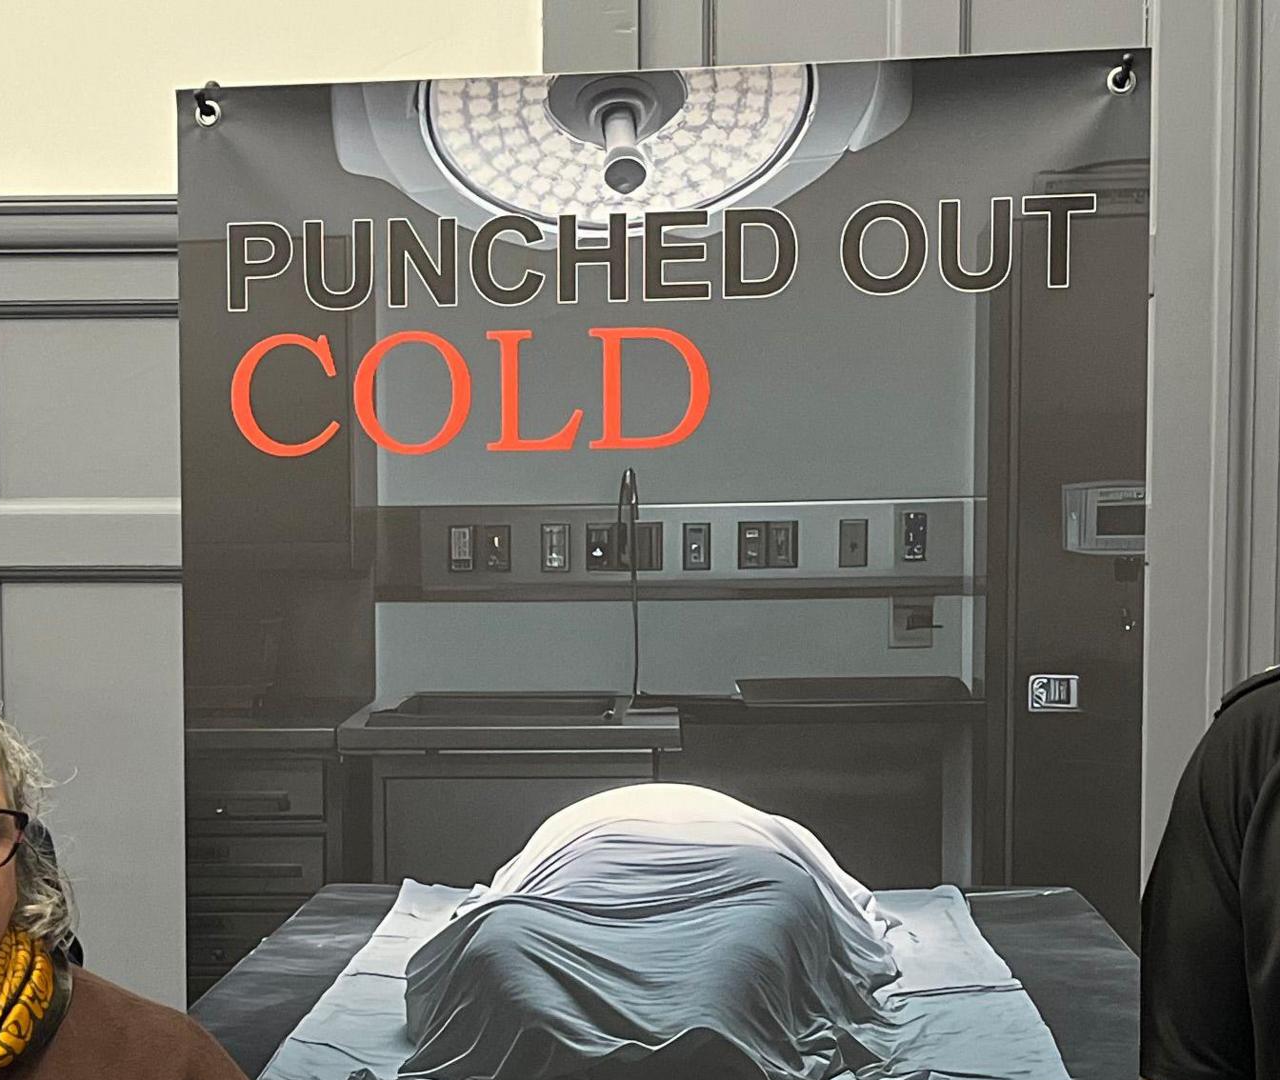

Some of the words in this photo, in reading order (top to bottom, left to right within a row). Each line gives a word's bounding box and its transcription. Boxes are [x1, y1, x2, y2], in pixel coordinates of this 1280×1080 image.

[225, 208, 799, 313] PUNCHED
[839, 193, 1099, 297] OUT
[230, 326, 712, 458] COLD
